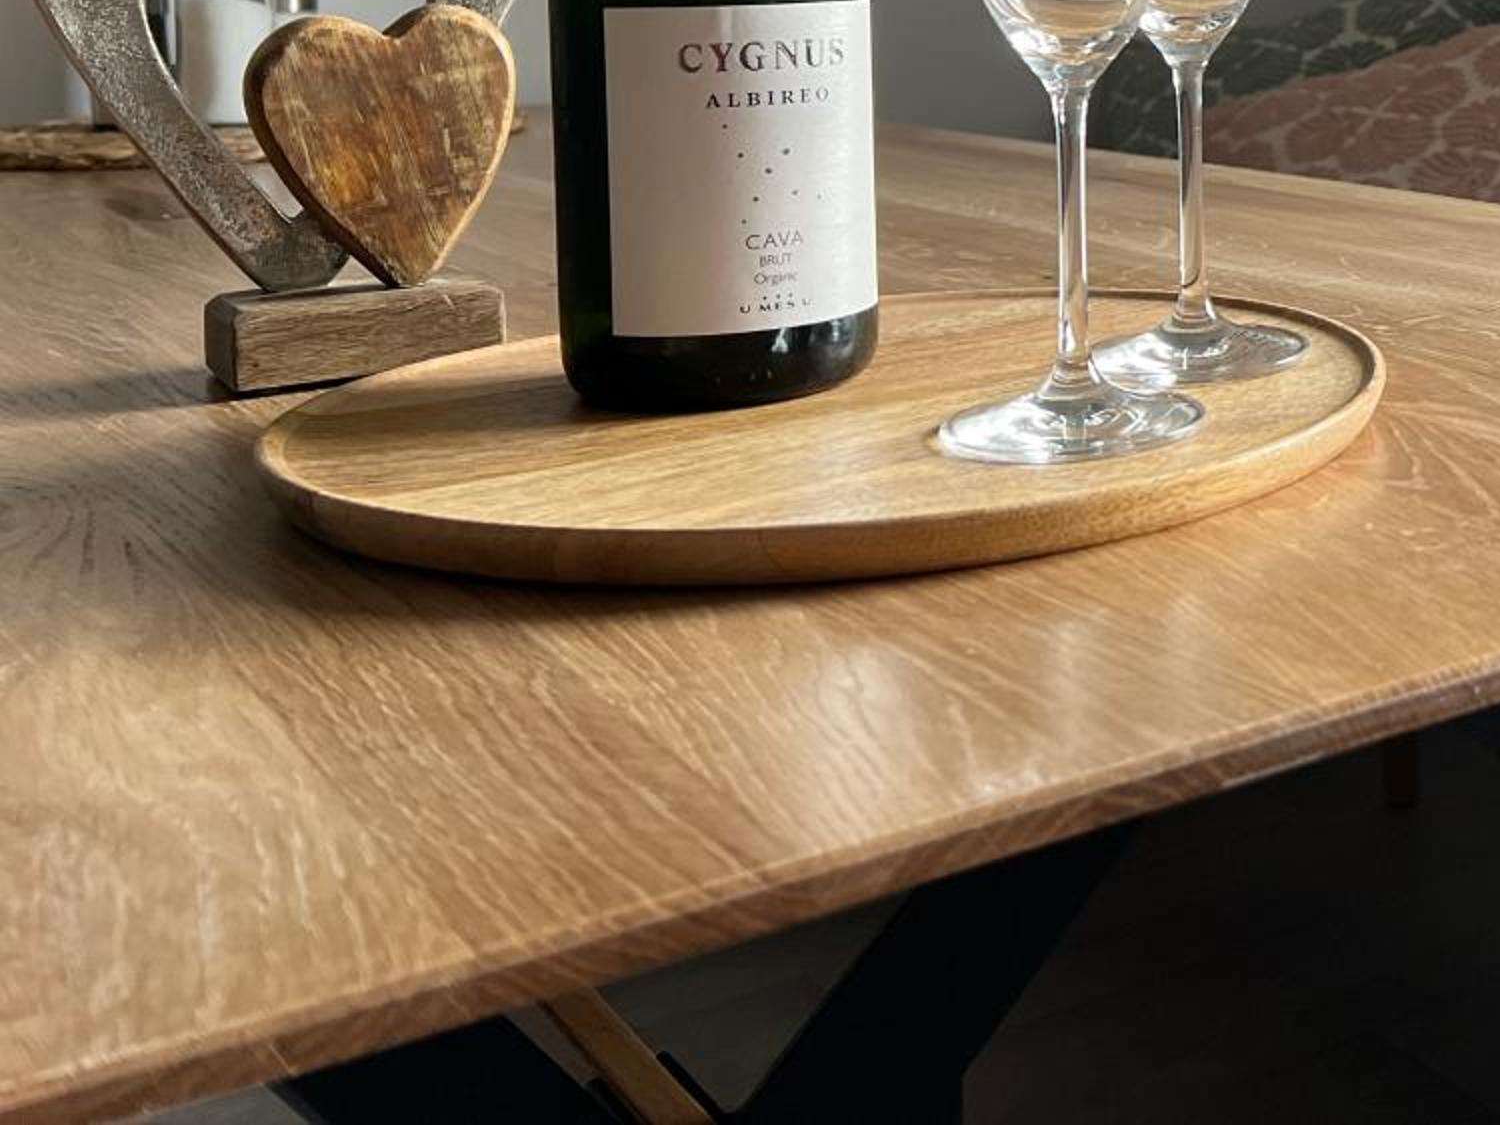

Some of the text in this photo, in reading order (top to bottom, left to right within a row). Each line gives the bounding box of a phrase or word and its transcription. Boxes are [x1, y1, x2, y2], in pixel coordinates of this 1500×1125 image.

[679, 38, 844, 73] CYGNUS
[705, 87, 830, 109] ALBIREO
[745, 230, 803, 250] CAVA
[759, 253, 792, 267] BRUT
